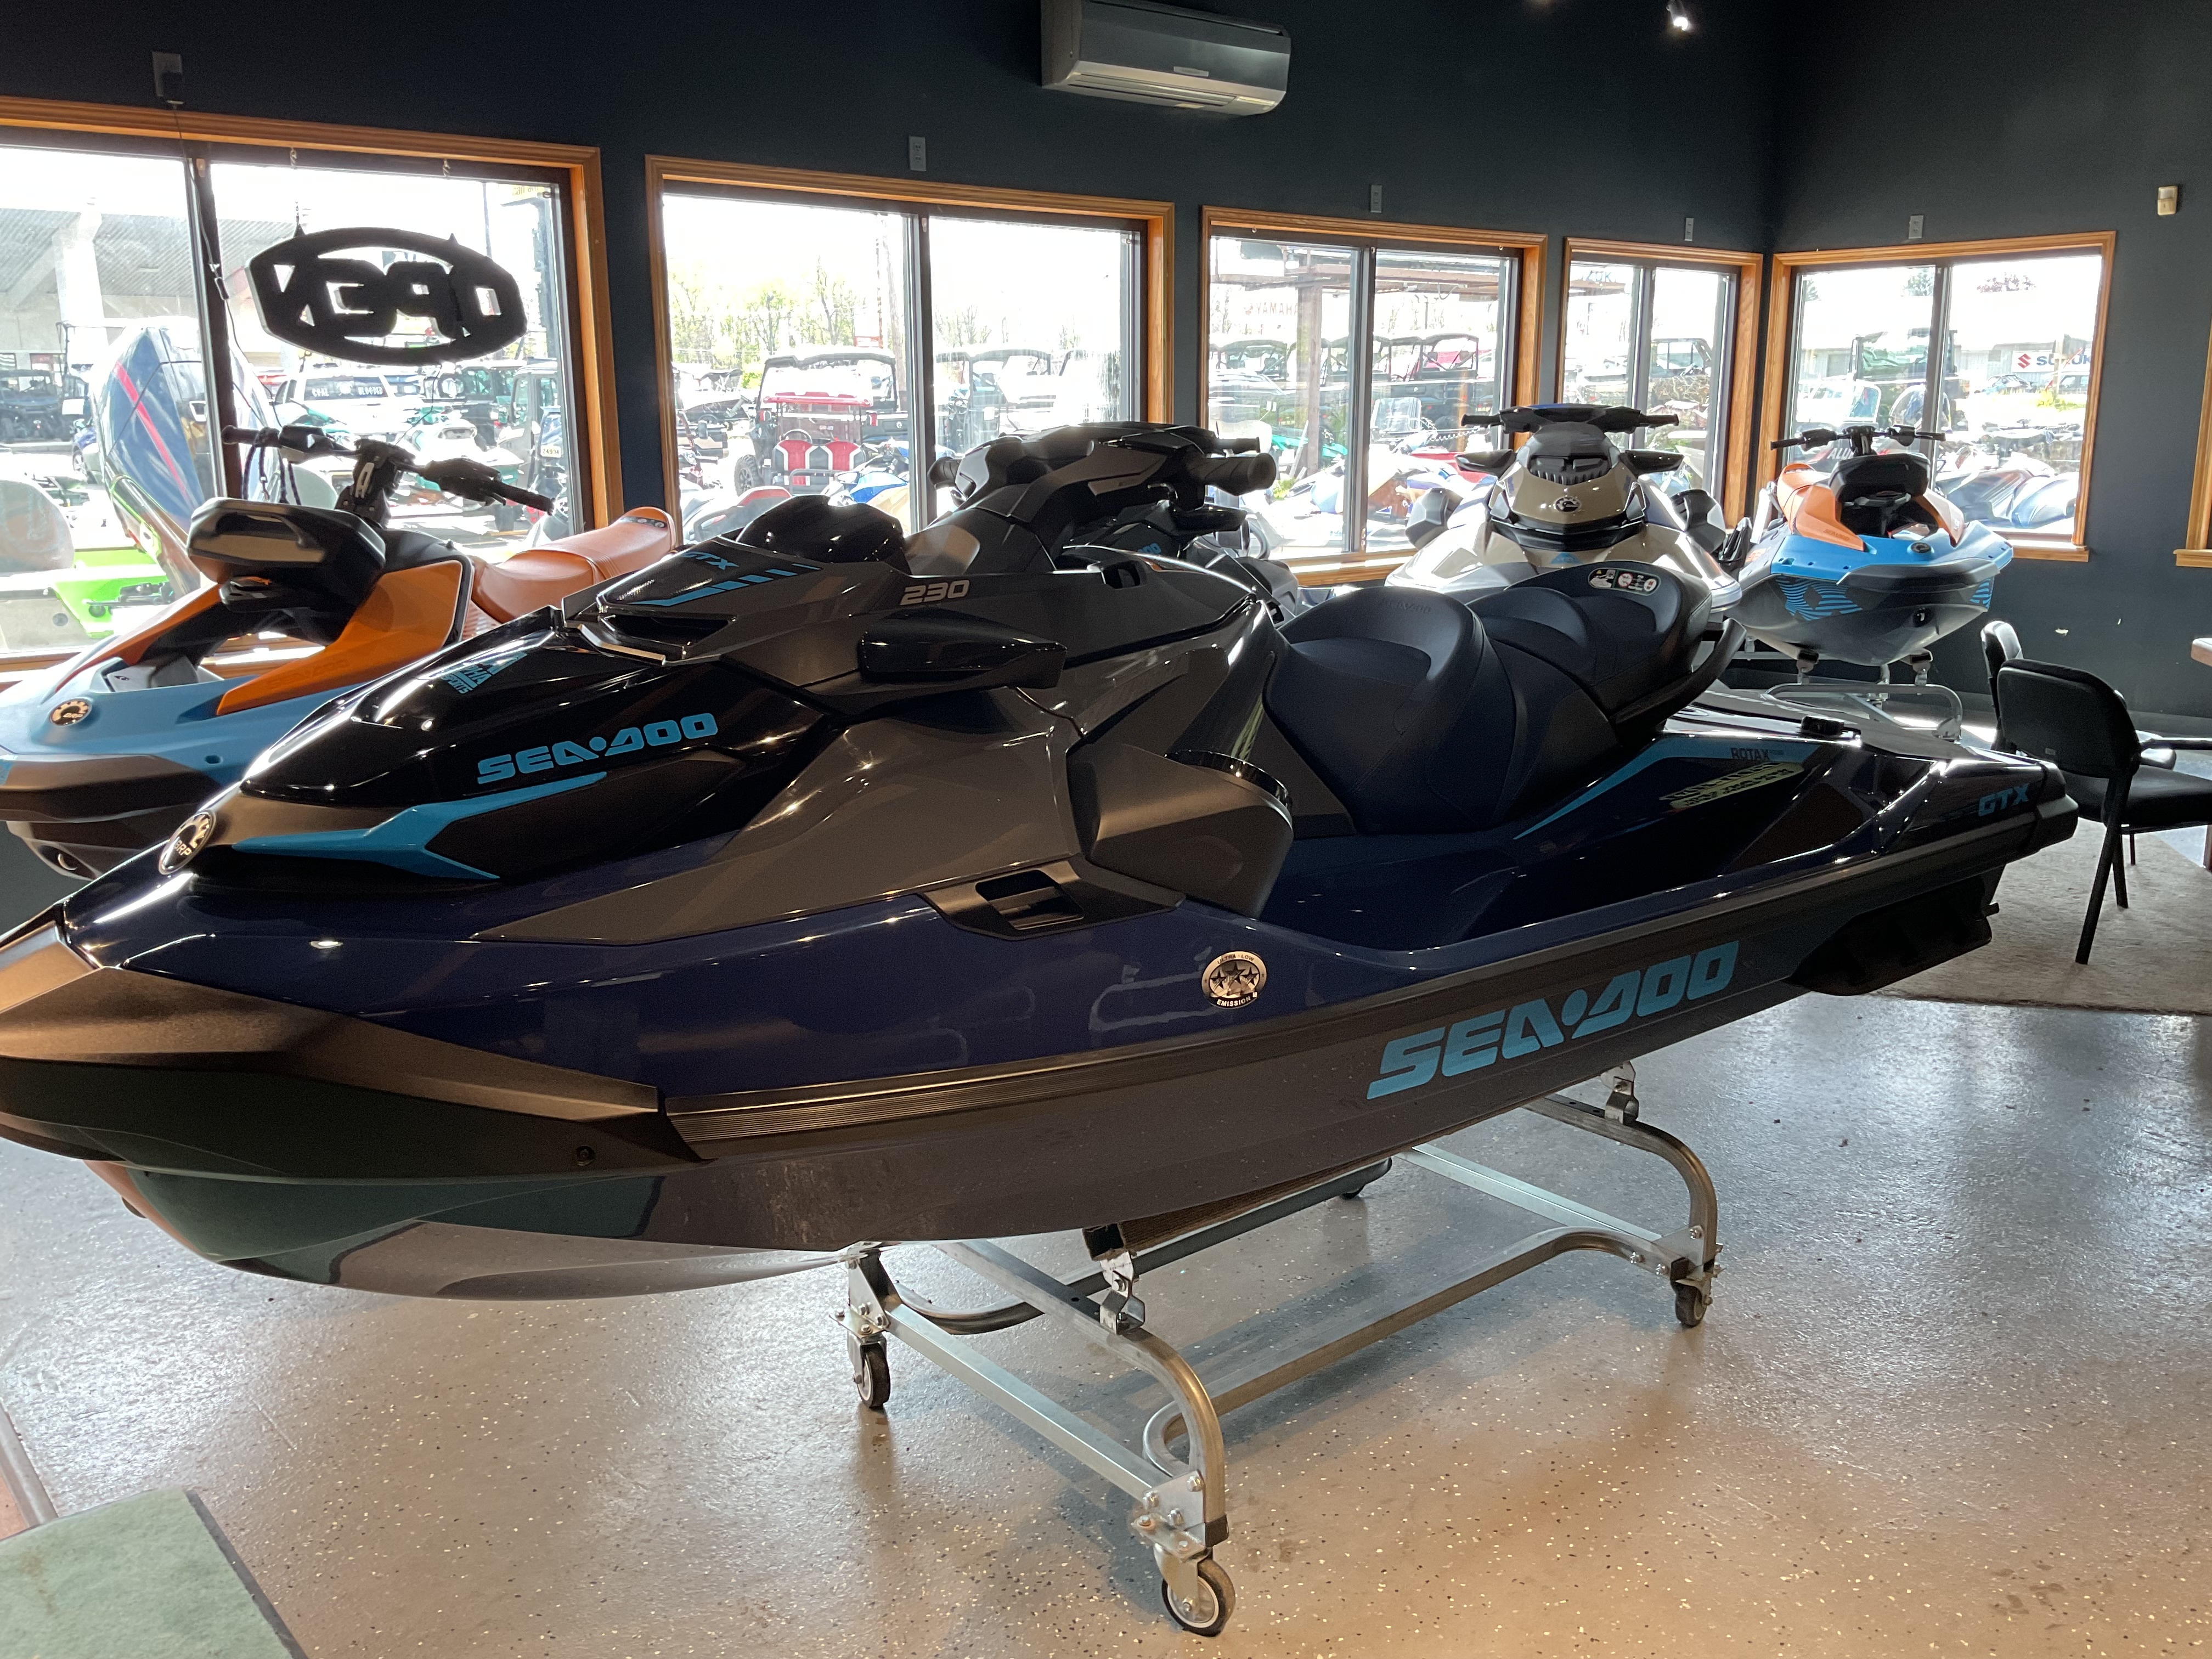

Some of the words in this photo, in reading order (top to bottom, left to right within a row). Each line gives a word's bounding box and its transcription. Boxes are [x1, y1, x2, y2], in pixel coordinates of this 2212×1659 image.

[1256, 302, 1299, 316] YAMAHA
[680, 551, 740, 570] GTX
[900, 579, 970, 606] 230
[464, 663, 492, 685] PHA
[1730, 747, 1770, 761] ROTAX
[1978, 782, 2030, 817] GTX
[174, 839, 193, 856] BRP
[1217, 954, 1237, 964] ULTRA
[1216, 995, 1251, 1007] EMISSION
